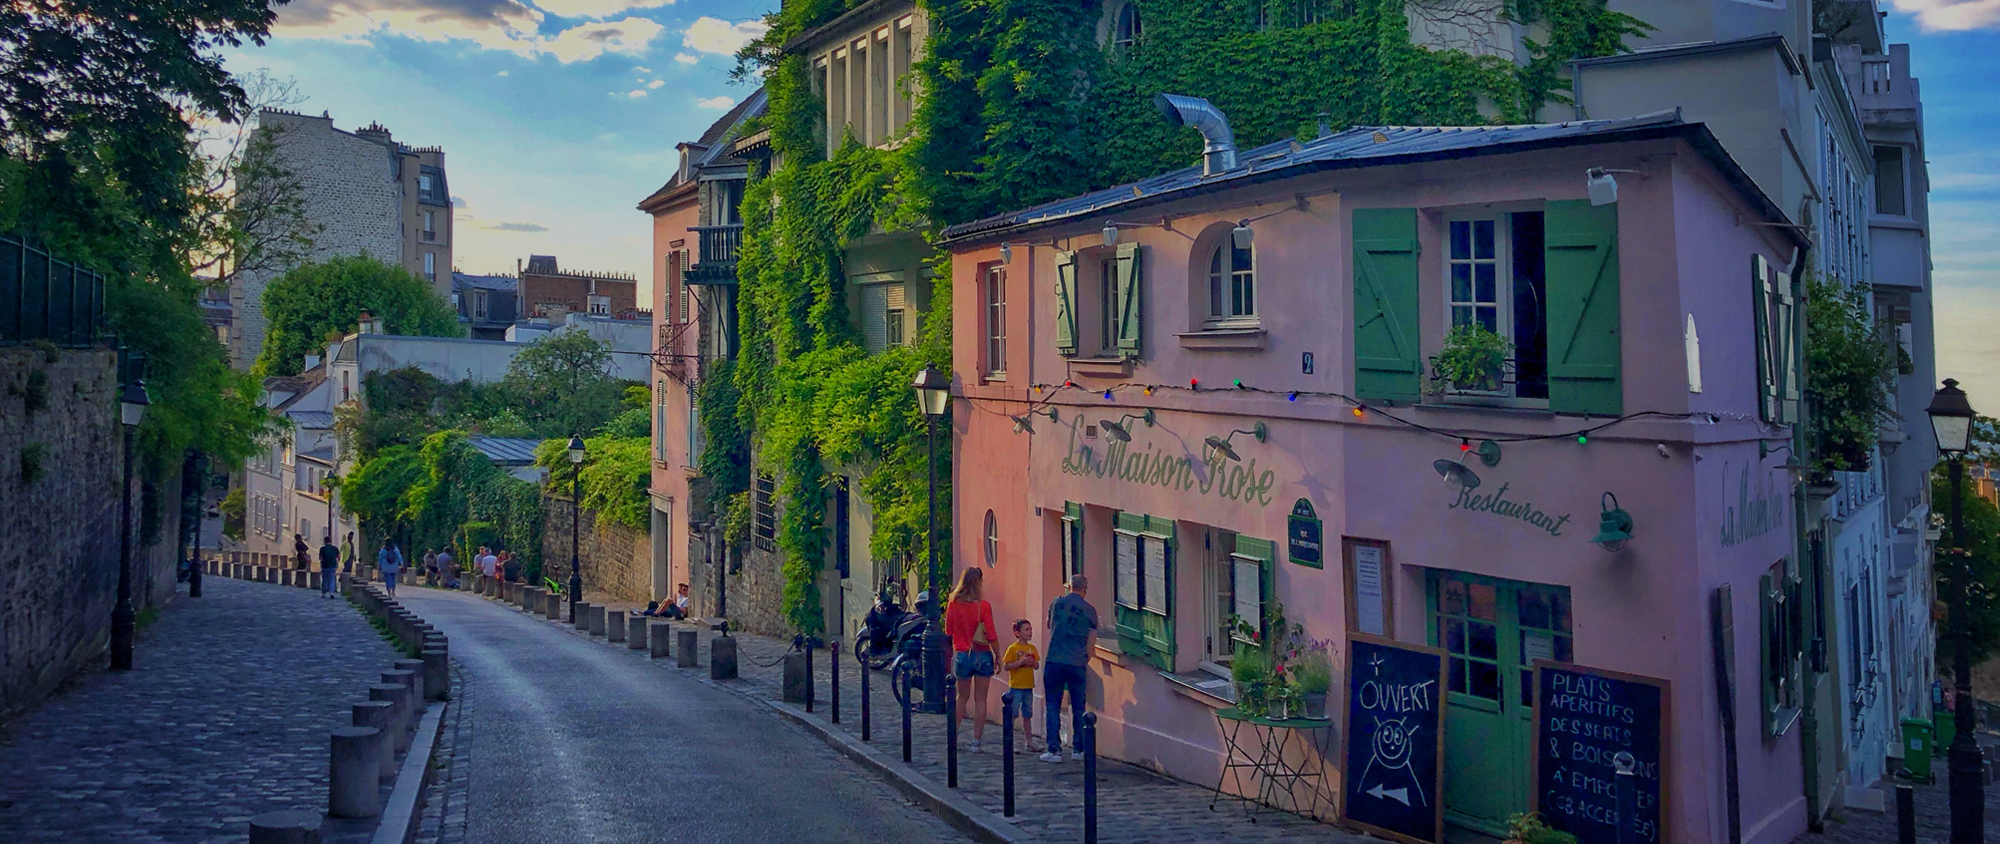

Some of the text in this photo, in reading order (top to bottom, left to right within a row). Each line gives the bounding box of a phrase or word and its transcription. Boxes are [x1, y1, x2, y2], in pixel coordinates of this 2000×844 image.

[1305, 353, 1311, 374] 2
[1062, 413, 1274, 507] La Maison Rose
[1449, 482, 1571, 537] Restaurant
[1360, 680, 1435, 712] OUVERT
[1552, 673, 1611, 701] PLATS
[1551, 694, 1634, 723] APERITIFS
[1551, 718, 1632, 746] DESSERTS
[1550, 737, 1658, 780] & BOISNS
[1553, 766, 1655, 809] À EMPOER
